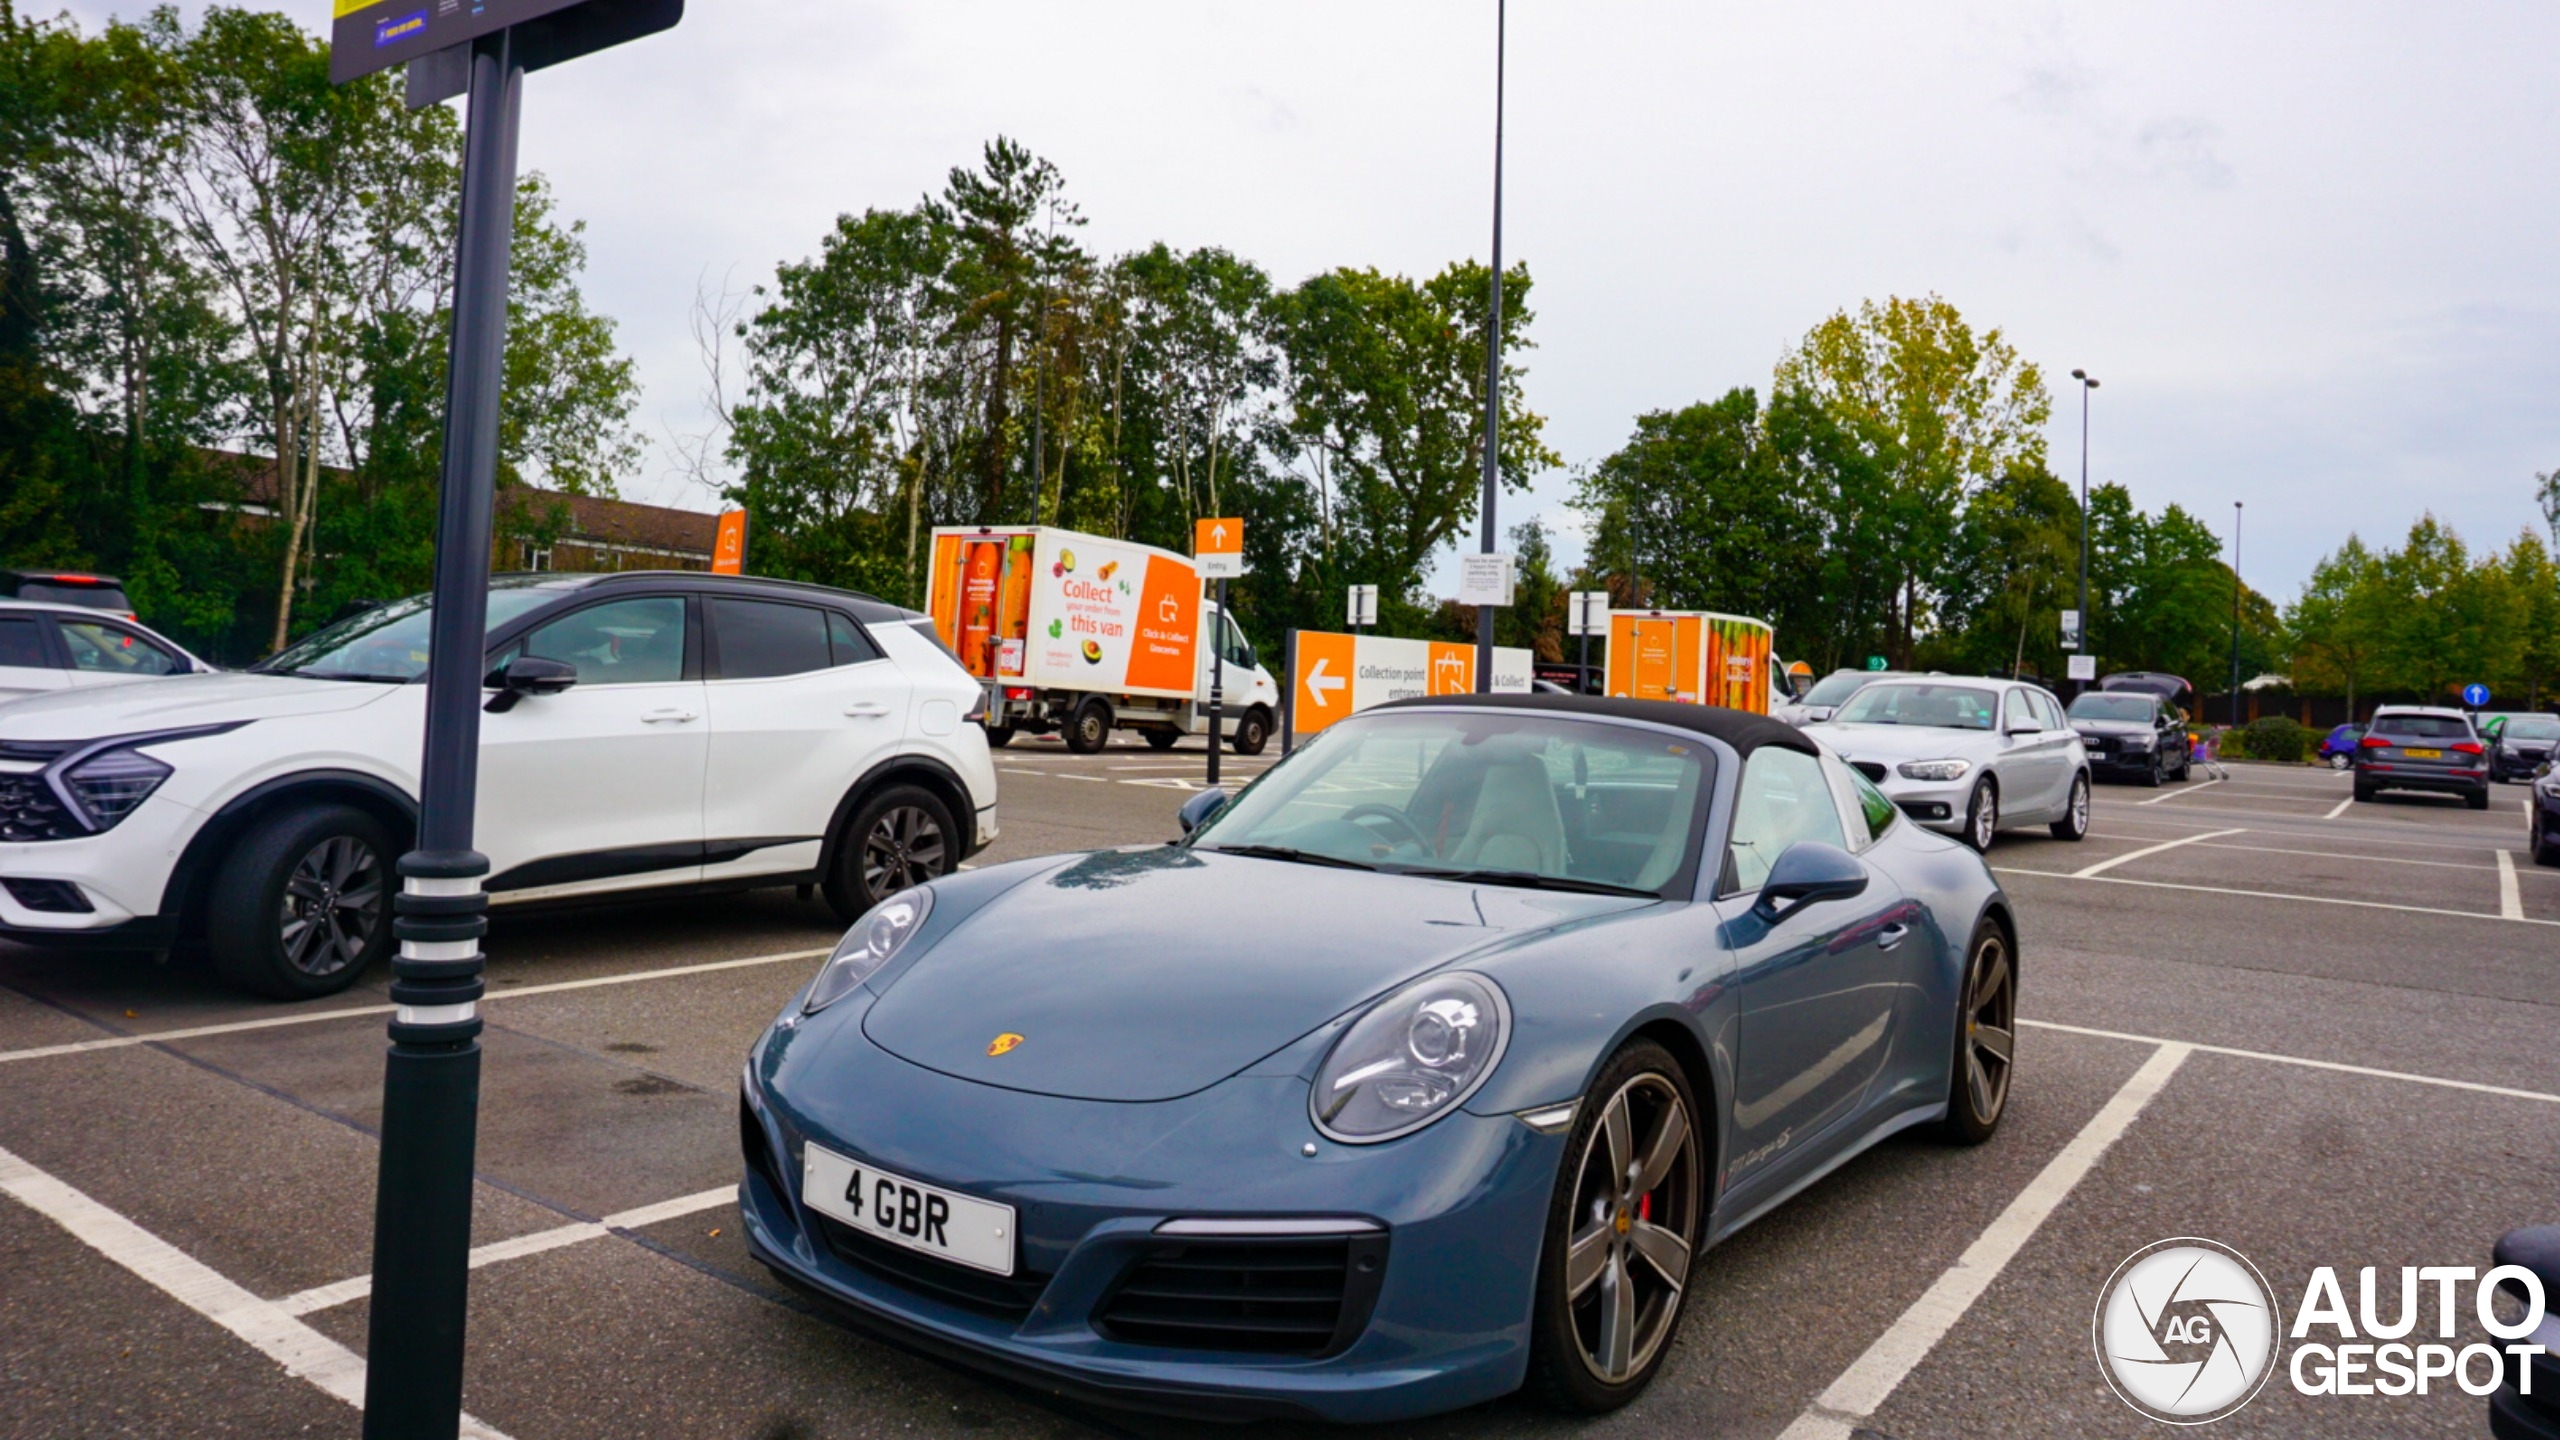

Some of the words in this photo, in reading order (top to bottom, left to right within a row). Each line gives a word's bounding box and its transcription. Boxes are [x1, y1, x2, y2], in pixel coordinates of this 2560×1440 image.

[1208, 562, 1227, 572] Entry
[1063, 579, 1112, 603] Collect
[1066, 603, 1083, 612] your
[1084, 604, 1103, 614] order
[1104, 605, 1121, 616] from
[1071, 614, 1097, 633] this
[1100, 622, 1123, 636] van
[1142, 628, 1160, 639] Click
[1167, 631, 1189, 644] Collect
[1359, 665, 1401, 680] Collection
[1403, 667, 1425, 682] point
[1494, 675, 1500, 686] &
[1501, 674, 1525, 688] Collect
[1389, 687, 1425, 699] entrance
[844, 1168, 864, 1217] 4
[874, 1178, 950, 1248] GBR
